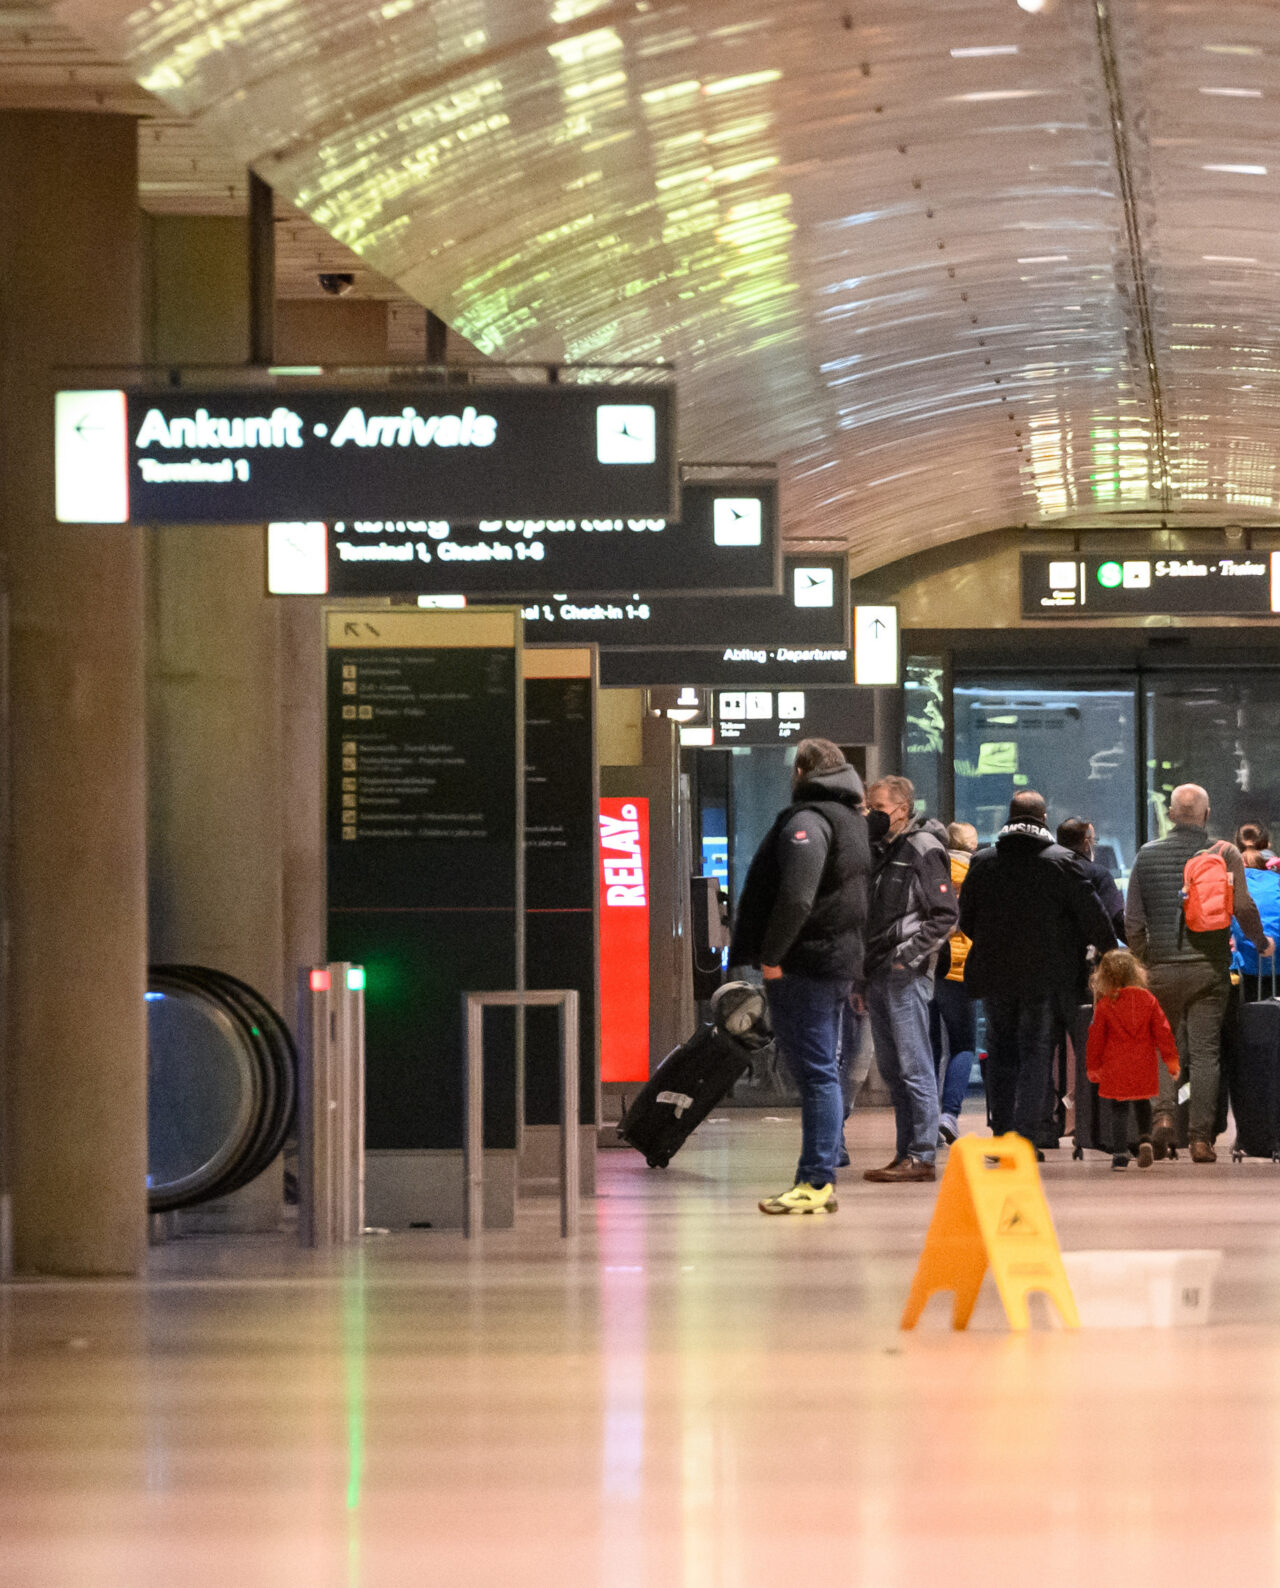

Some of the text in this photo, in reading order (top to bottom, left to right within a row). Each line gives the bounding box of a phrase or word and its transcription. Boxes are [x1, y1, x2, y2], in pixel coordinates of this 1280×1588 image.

[135, 406, 498, 449] Ankunft Arrivals
[234, 458, 250, 482] 1
[559, 604, 624, 620] Check-in
[722, 647, 848, 664] Abflug Departures
